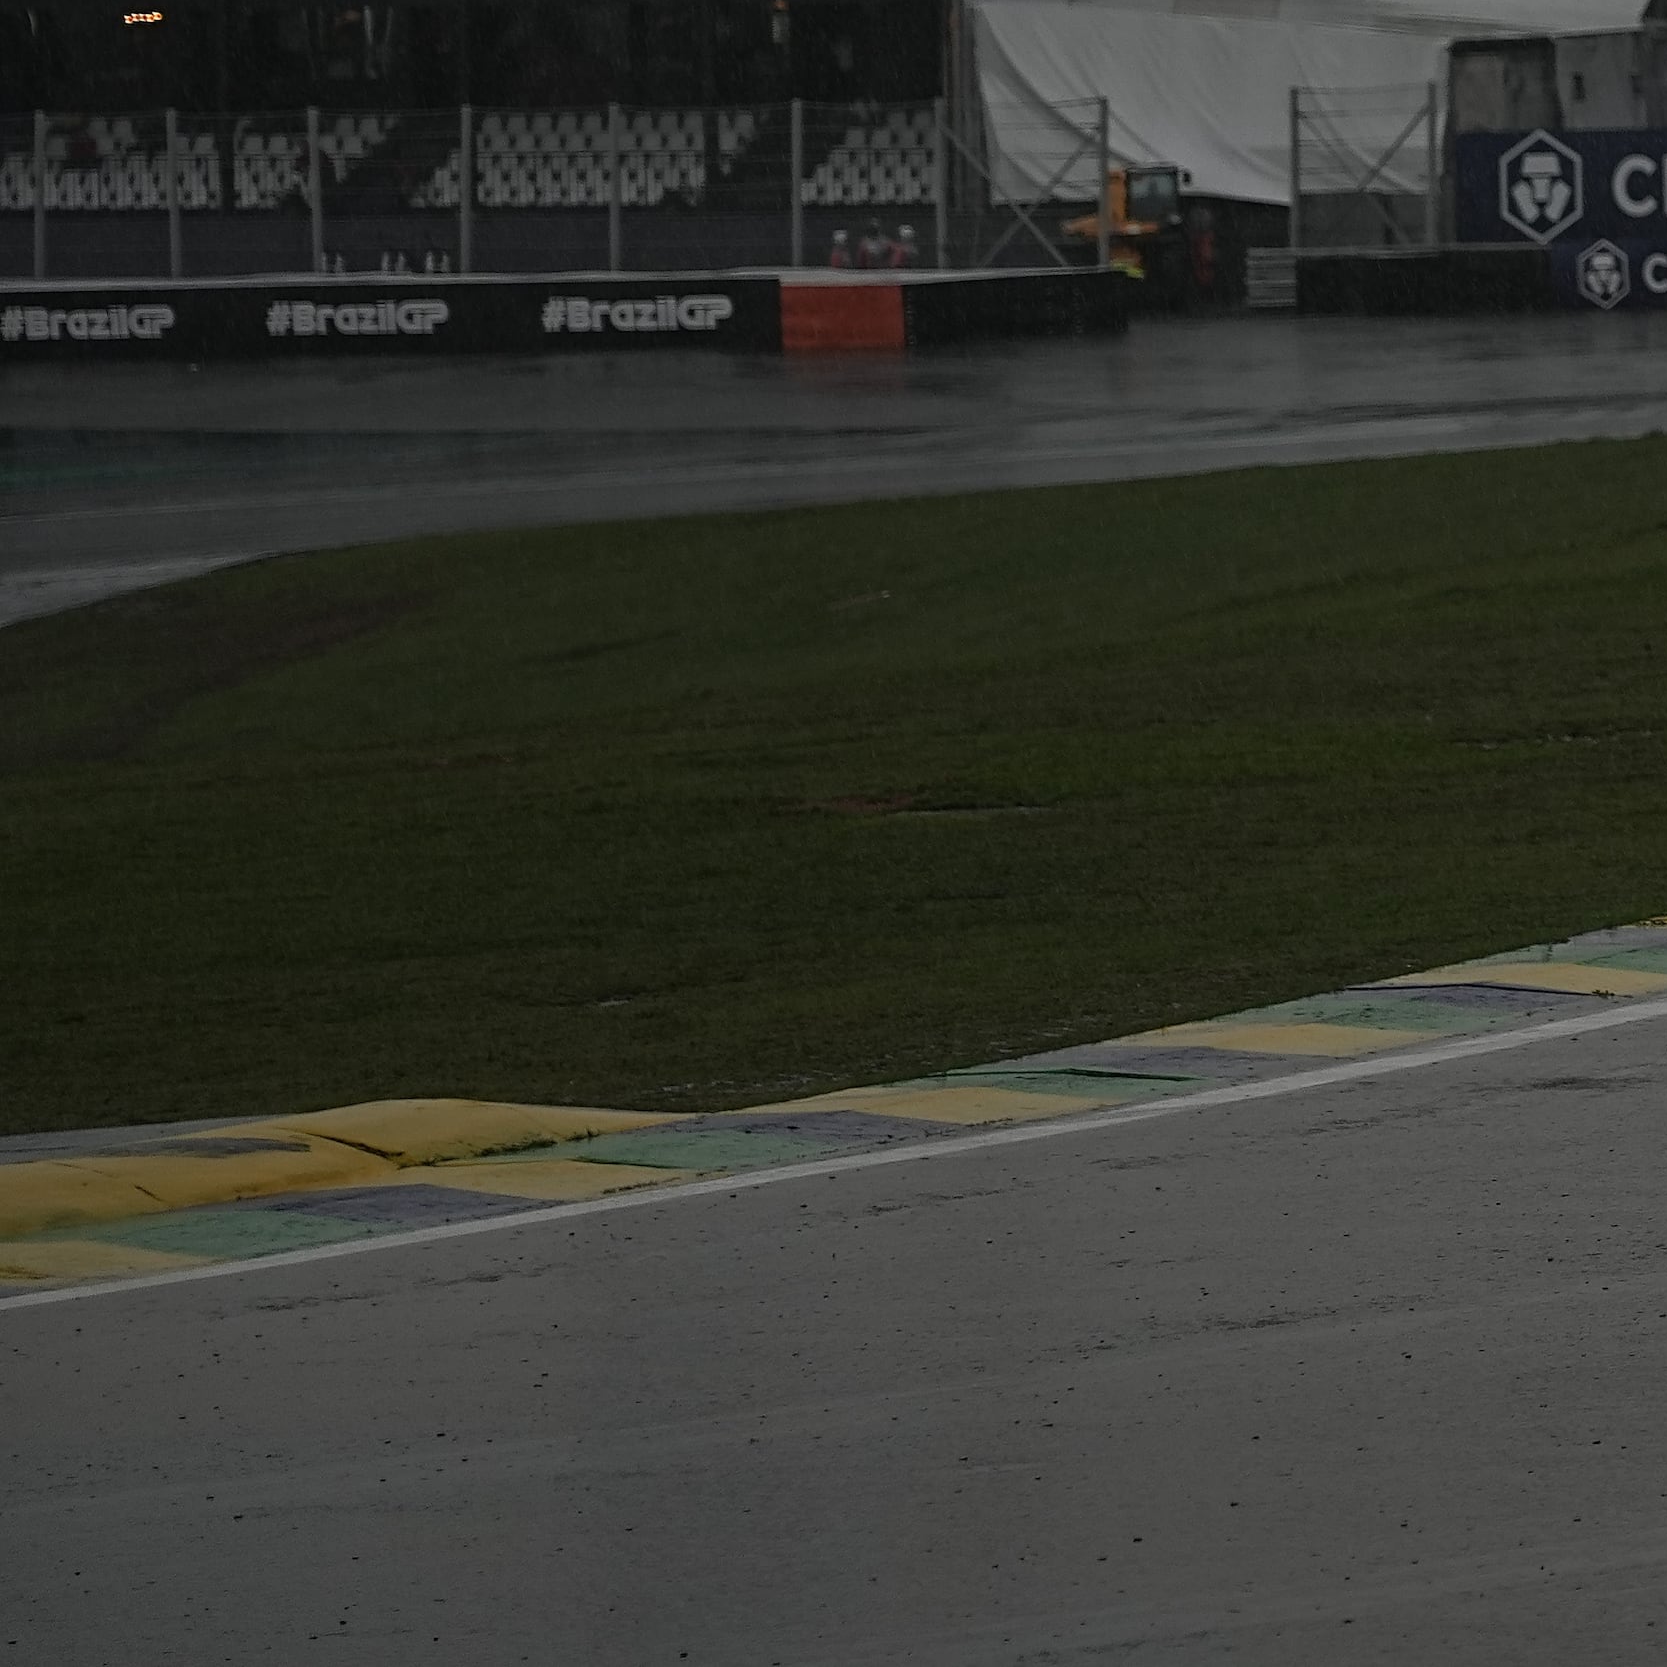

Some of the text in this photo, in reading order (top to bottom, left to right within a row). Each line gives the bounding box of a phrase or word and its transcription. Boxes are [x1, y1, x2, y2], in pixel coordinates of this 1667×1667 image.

[0, 304, 175, 341] #BrazilGP
[266, 298, 448, 335] #BrazilGP
[542, 294, 732, 332] #BrazilGP
